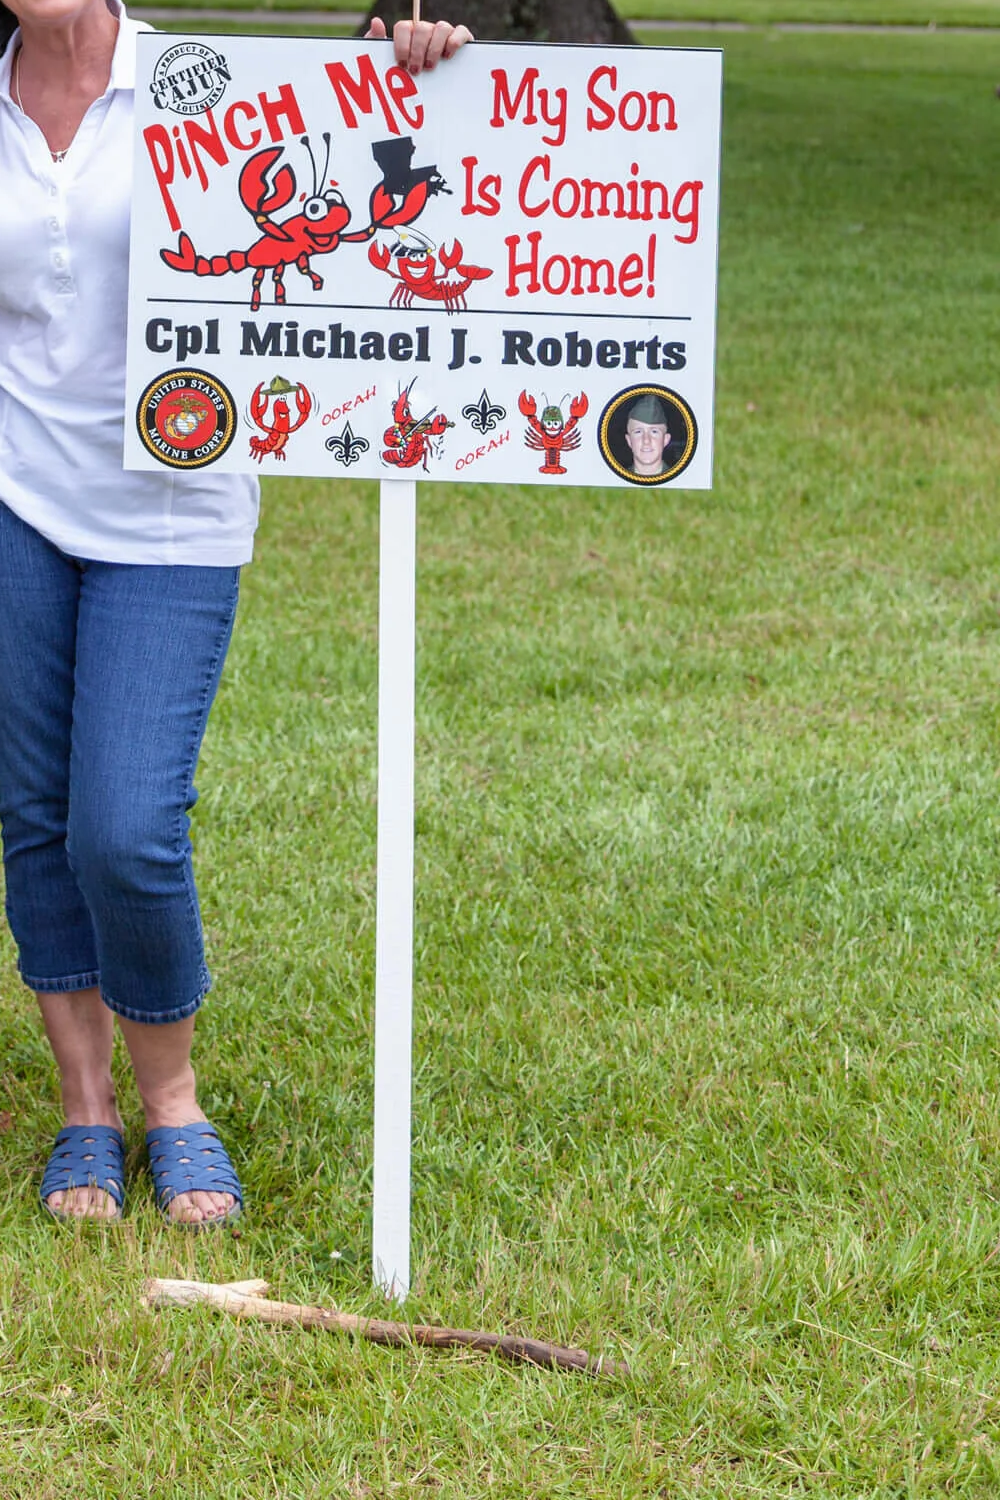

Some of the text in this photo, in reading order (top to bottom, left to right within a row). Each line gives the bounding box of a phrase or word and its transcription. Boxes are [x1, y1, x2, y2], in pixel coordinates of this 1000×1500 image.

[149, 54, 226, 94] CERTIFIED
[160, 46, 197, 68] PRODUCT
[199, 48, 211, 57] OF
[153, 63, 233, 110] CAJUN
[176, 86, 222, 113] LOUISIANA
[489, 65, 679, 146] My Son
[460, 155, 705, 244] Is Coming
[504, 231, 658, 299] Home!
[144, 317, 688, 371] Cpl Michael J. Roberts
[148, 378, 225, 411] UNITED STATES
[321, 385, 377, 427] OORAH
[148, 427, 224, 460] MARINE CORPS
[455, 430, 510, 471] OORAH
